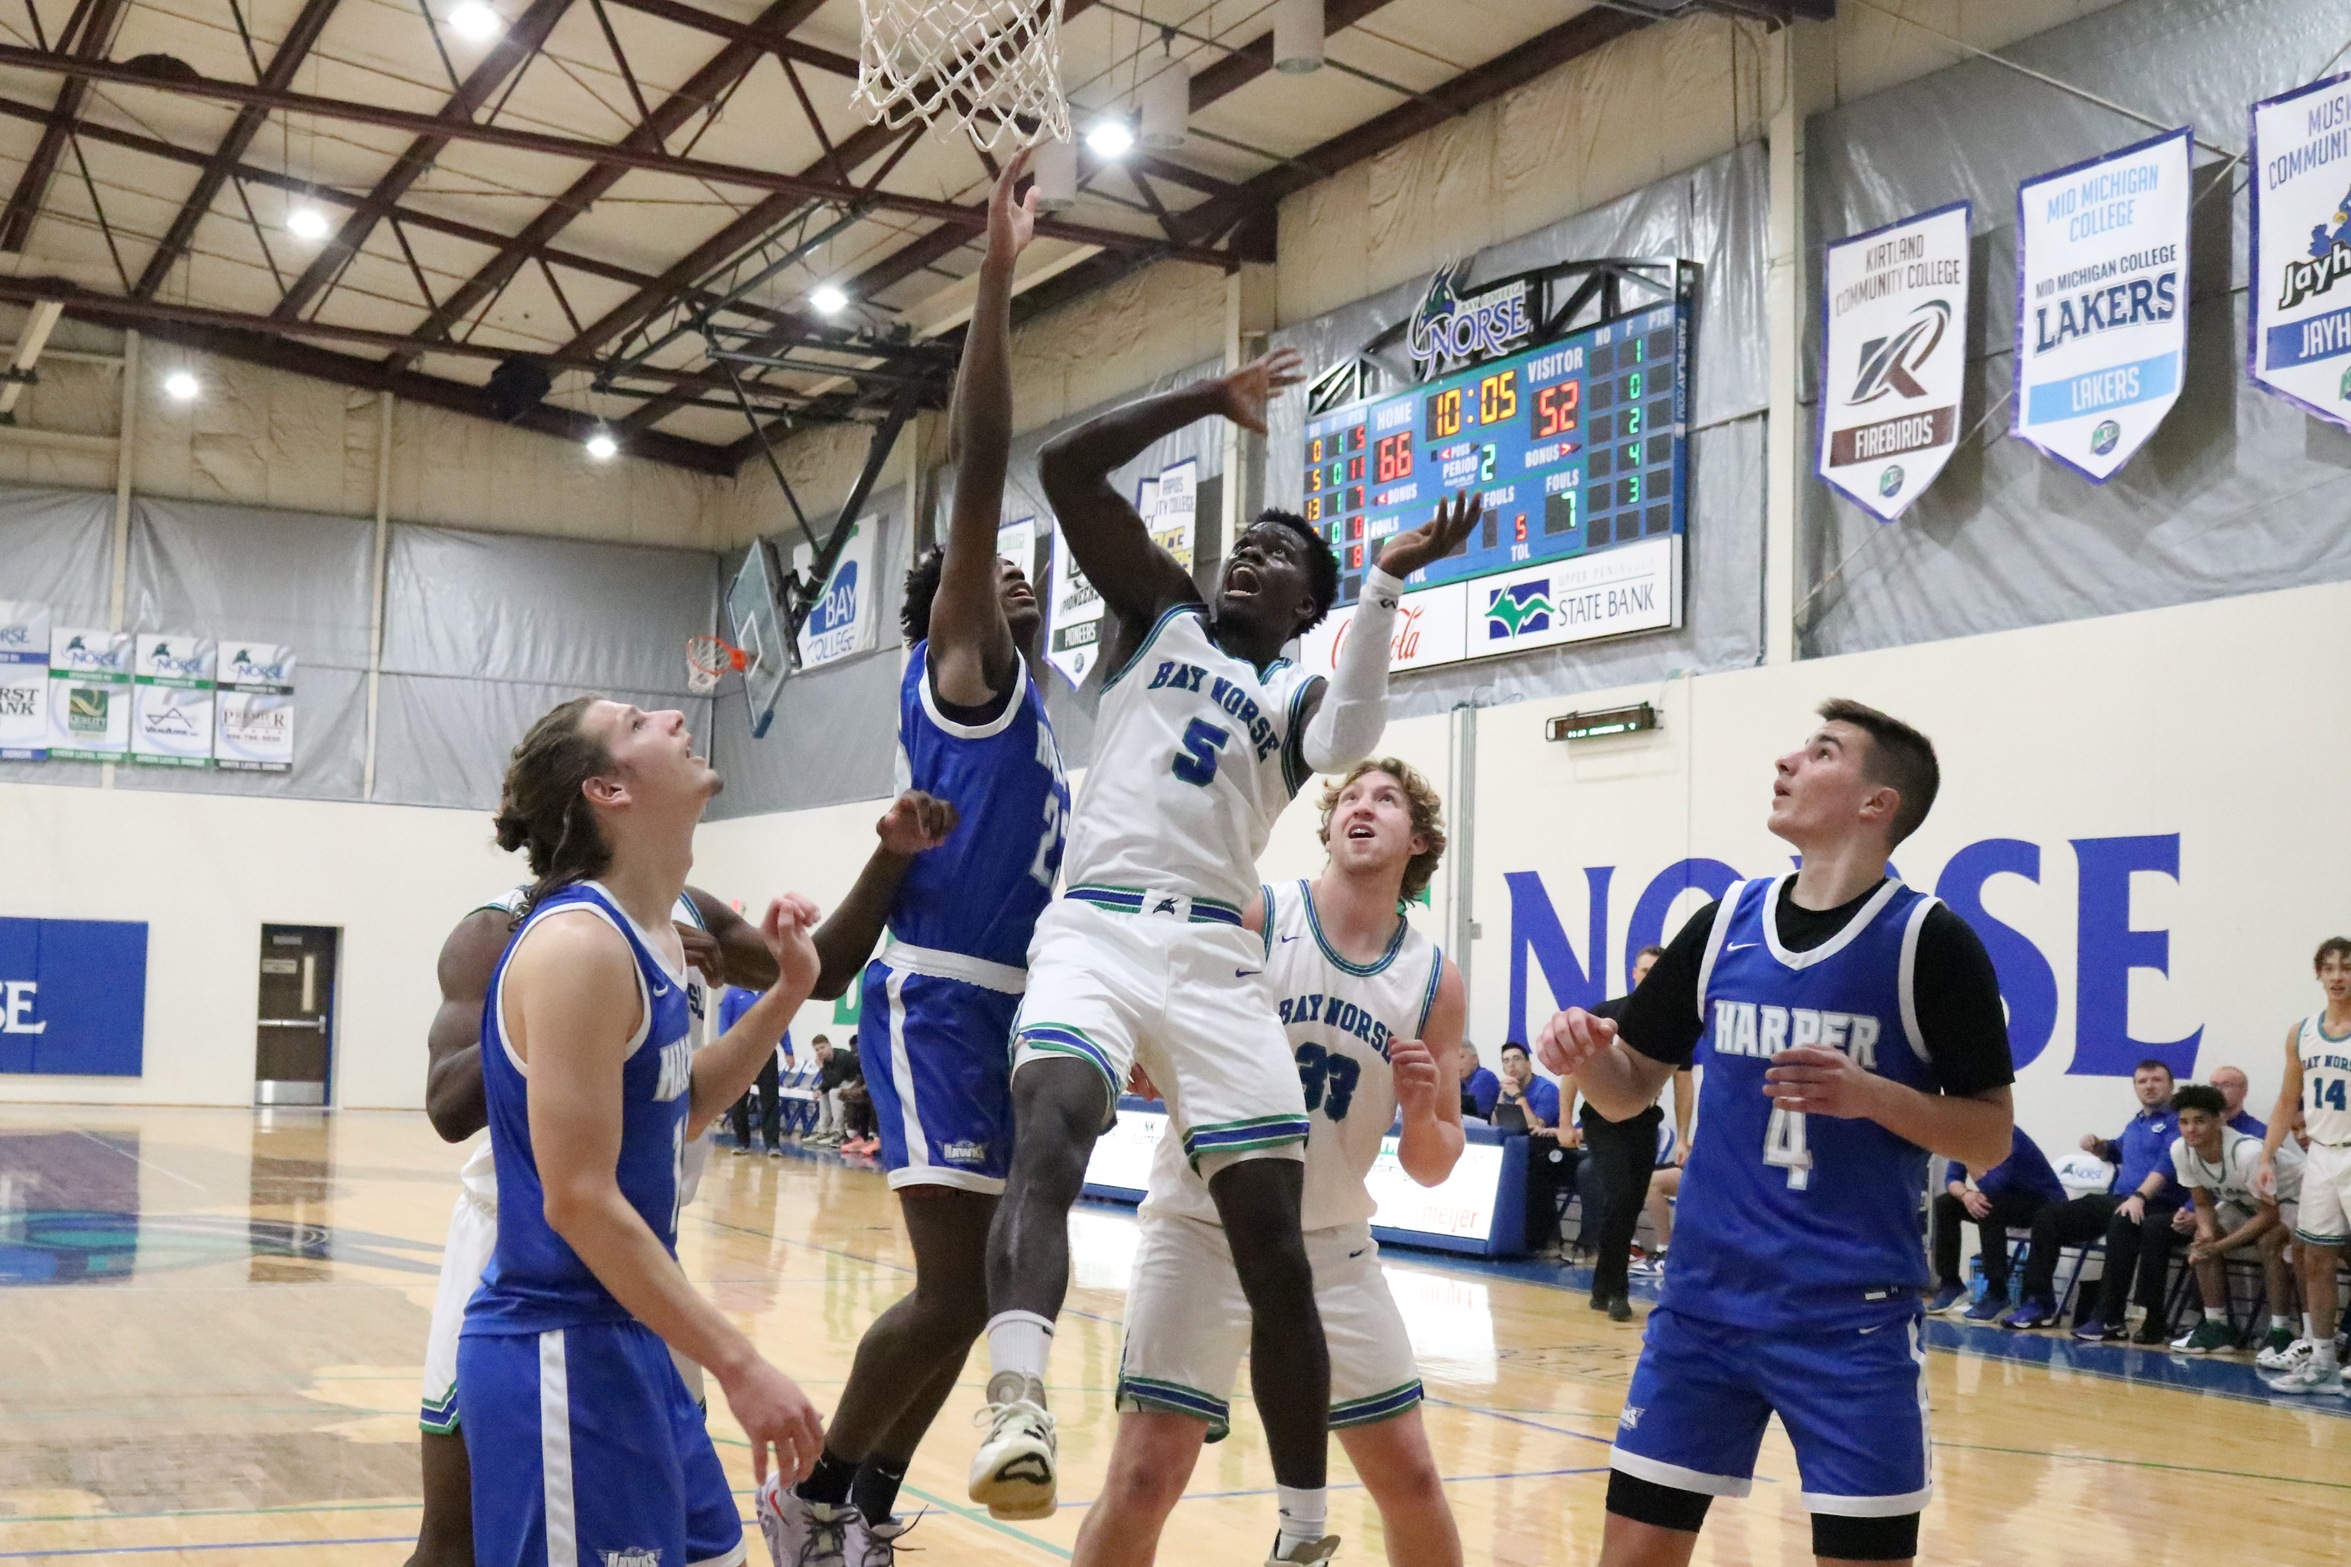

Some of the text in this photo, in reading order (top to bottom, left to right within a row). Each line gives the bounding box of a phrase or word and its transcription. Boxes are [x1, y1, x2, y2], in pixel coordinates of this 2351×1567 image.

[2047, 164, 2160, 225] MID MICHIGAN
[2069, 198, 2136, 243] COLLEGE
[1866, 234, 1925, 274] KIRTLAND
[2035, 243, 2178, 300] MID MICHIGAN COLLEGE
[1836, 259, 1961, 318] COMMUNITY COLLEGE
[1595, 307, 1671, 347] NO F PTS
[2035, 270, 2178, 356] LAKERS
[1424, 294, 1530, 382] NORSE
[1636, 338, 1642, 363] 1
[1527, 345, 1585, 384] VISITOR
[1629, 372, 1641, 400] 0
[2071, 365, 2140, 413] LAKERS
[1376, 401, 1413, 432] HOME
[1538, 379, 1580, 437] 52
[1629, 406, 1641, 435] 2
[1313, 424, 1367, 464] 0 1 5
[1524, 443, 1560, 468] BONUS
[1628, 441, 1640, 467] 4
[1854, 413, 1934, 460] FIREBIRDS
[1311, 455, 1365, 492] 5 0 11
[1379, 430, 1413, 483] 66
[1443, 455, 1478, 479] PERIOD
[1481, 443, 1497, 482] 2
[1387, 482, 1418, 506] BONUS
[1483, 485, 1516, 509] FOULS
[1546, 468, 1580, 493] FOULS
[1628, 475, 1640, 504] 3
[1307, 484, 1365, 522] 13 1 7
[1561, 490, 1577, 528] 7
[1331, 514, 1364, 545] 0 0
[1371, 515, 1400, 537] FOULS
[1514, 513, 1527, 542] 5
[1352, 543, 1364, 569] 8
[1511, 543, 1531, 562] TOL
[825, 584, 857, 629] BAY
[1558, 583, 1655, 627] STATE BANK
[1064, 621, 1097, 649] PIONEERS
[0, 701, 36, 716] NK
[1147, 661, 1281, 764] BAY NORSE
[1171, 715, 1231, 788] 5
[1504, 832, 2206, 1080] NOSE
[0, 980, 47, 1035] E
[1279, 994, 1324, 1026] BAY
[1713, 999, 1881, 1070] HARPER
[1295, 1041, 1362, 1124] 33
[2313, 1077, 2347, 1112] 14
[1762, 1081, 1814, 1191] 4
[1422, 1205, 1479, 1234] meijer
